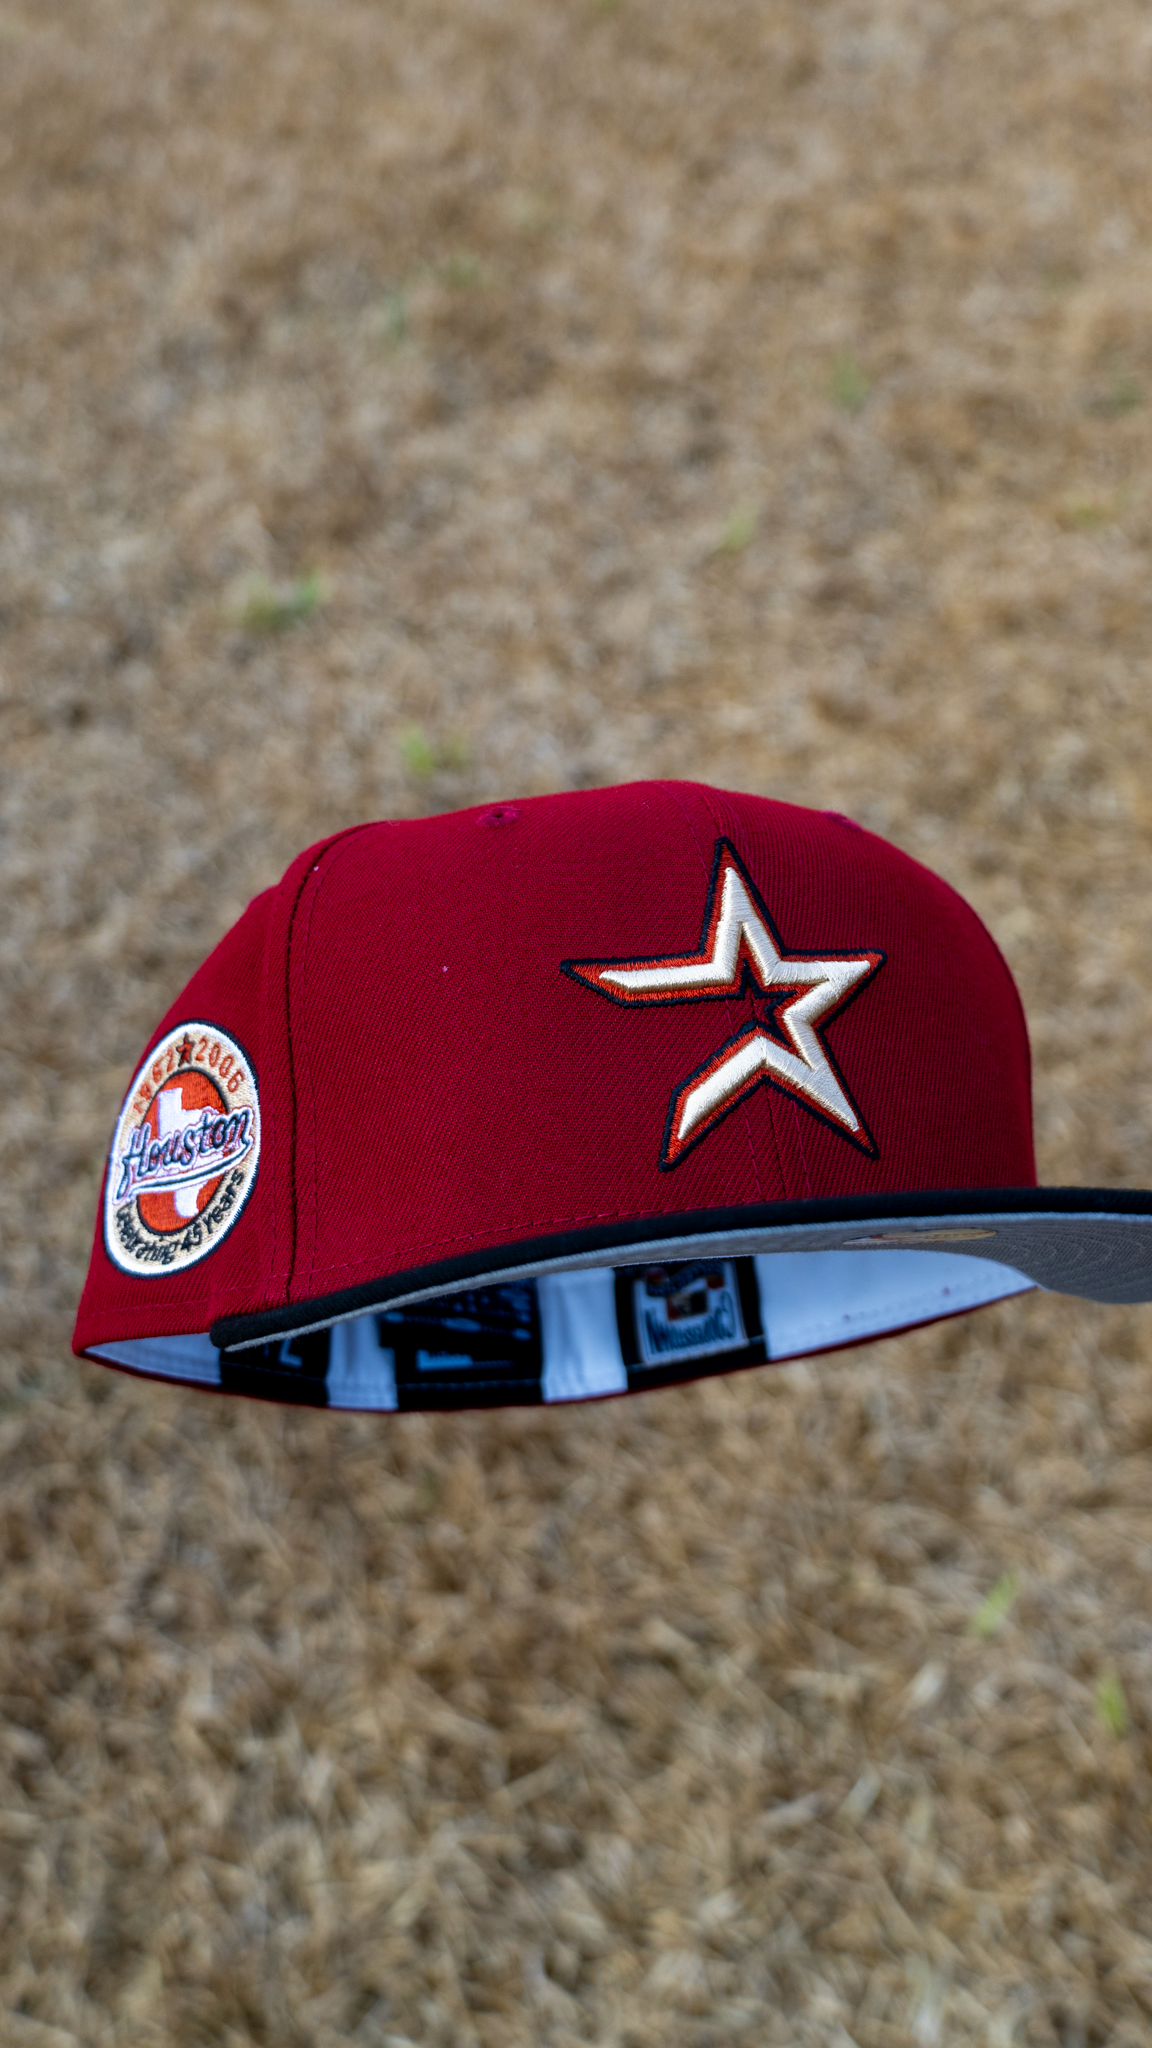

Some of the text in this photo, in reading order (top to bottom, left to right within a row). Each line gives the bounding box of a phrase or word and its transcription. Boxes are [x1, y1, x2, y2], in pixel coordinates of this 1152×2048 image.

[134, 1038, 245, 1114] 1962 2006
[115, 1108, 252, 1201] Houston
[181, 1223, 202, 1252] 45
